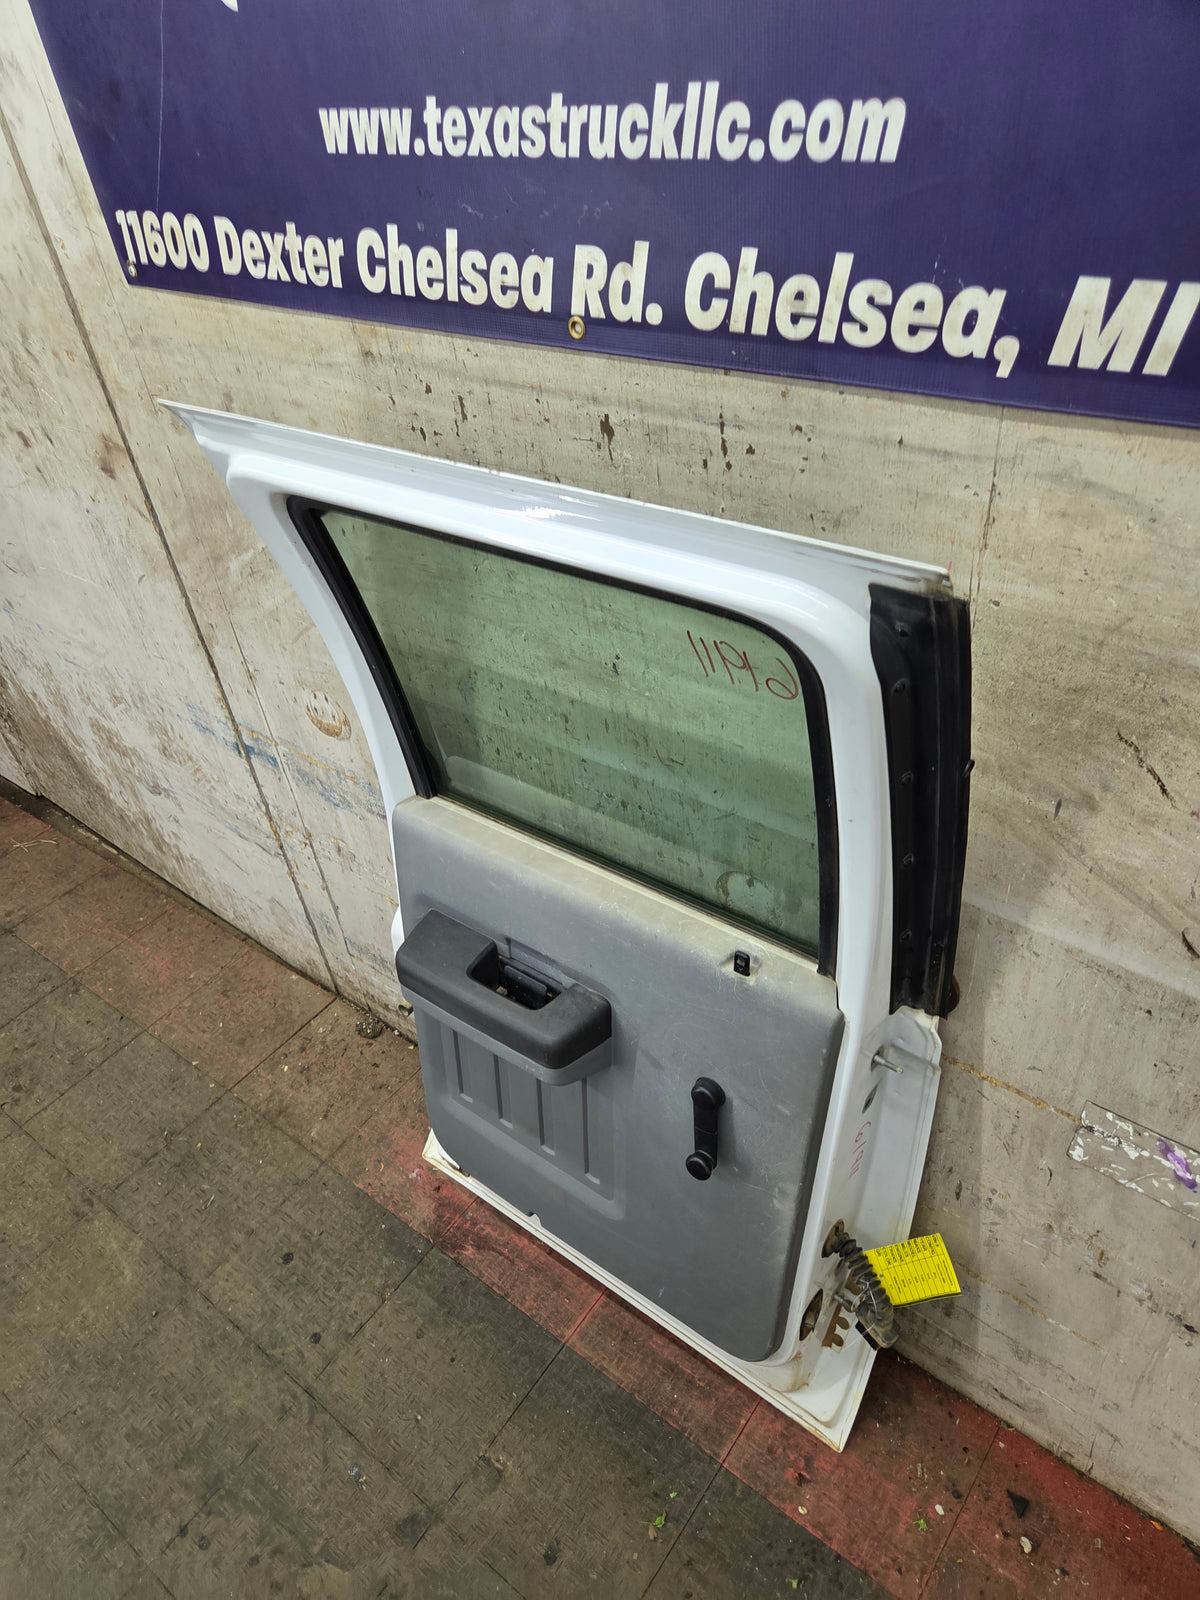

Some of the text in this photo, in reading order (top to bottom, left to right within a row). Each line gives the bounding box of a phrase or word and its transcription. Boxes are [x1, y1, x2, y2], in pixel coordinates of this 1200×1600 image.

[319, 81, 906, 162] www.texastruckllc.com
[116, 210, 1200, 378] 11600 Dexter Chelsea Rd. Chelsea, MI
